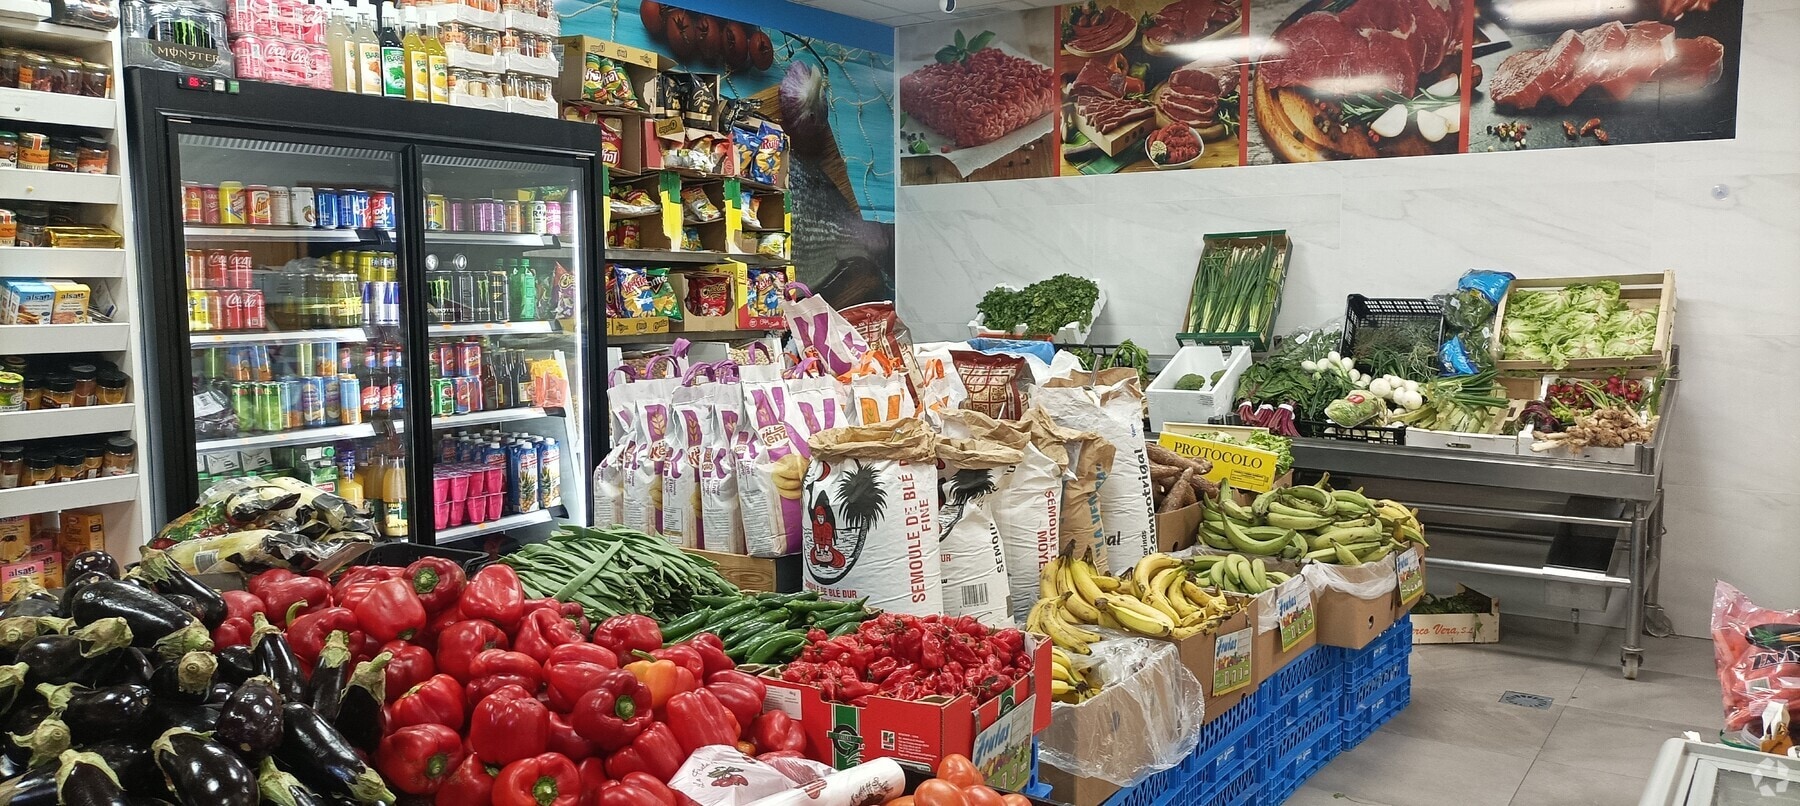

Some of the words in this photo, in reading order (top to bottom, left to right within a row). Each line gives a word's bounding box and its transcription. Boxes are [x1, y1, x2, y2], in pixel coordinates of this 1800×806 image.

[1173, 441, 1263, 469] PROTOCOLO
[897, 473, 916, 501] BLÉ
[919, 498, 931, 532] FINE
[1044, 490, 1057, 552] SEMOULE
[1037, 530, 1049, 572] MOYE
[906, 531, 926, 603] SEMOULE
[842, 589, 858, 599] DUR
[1433, 623, 1460, 636] Vera,
